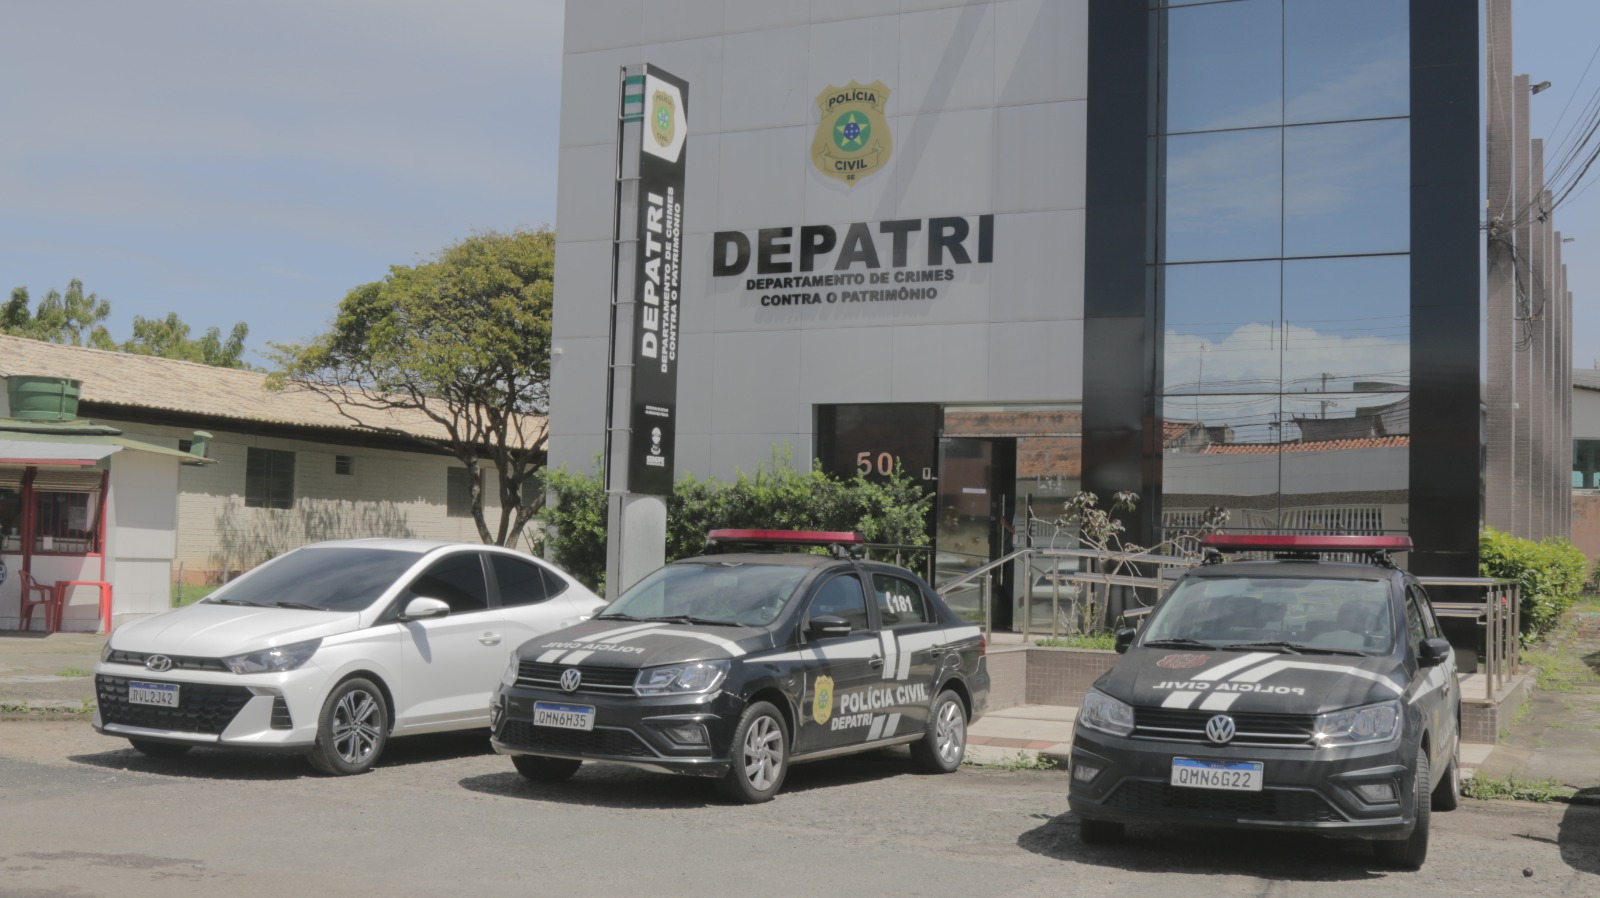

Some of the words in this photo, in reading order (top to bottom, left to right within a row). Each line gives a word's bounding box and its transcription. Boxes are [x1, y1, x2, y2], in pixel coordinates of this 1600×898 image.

[829, 89, 876, 108] POLÍCIA
[834, 159, 868, 171] CIVIL
[666, 186, 674, 238] CRIMES
[665, 241, 672, 260] DE
[671, 203, 680, 287] PATRIMÔNIO
[713, 214, 994, 277] DEPATRI
[642, 192, 664, 358] DEPATRI
[746, 273, 864, 290] DEPARTAMENTO
[869, 272, 890, 284] DE
[894, 269, 954, 282] CRIMES
[671, 290, 678, 300] O
[761, 292, 822, 306] CONTRA
[827, 292, 838, 304] O
[841, 287, 938, 303] PATRIMÔNIO
[661, 263, 671, 373] DEPARTAMENTO
[669, 304, 677, 360] CONTRA
[857, 452, 893, 476] 50
[892, 595, 913, 612] 181
[134, 689, 173, 704] RVL2J42
[840, 686, 894, 714] POLÍCIA
[896, 683, 928, 704] CIVIL
[538, 711, 587, 728] QMN6H35
[831, 713, 873, 731] DEPATRI
[1179, 768, 1252, 788] QMN6G22
